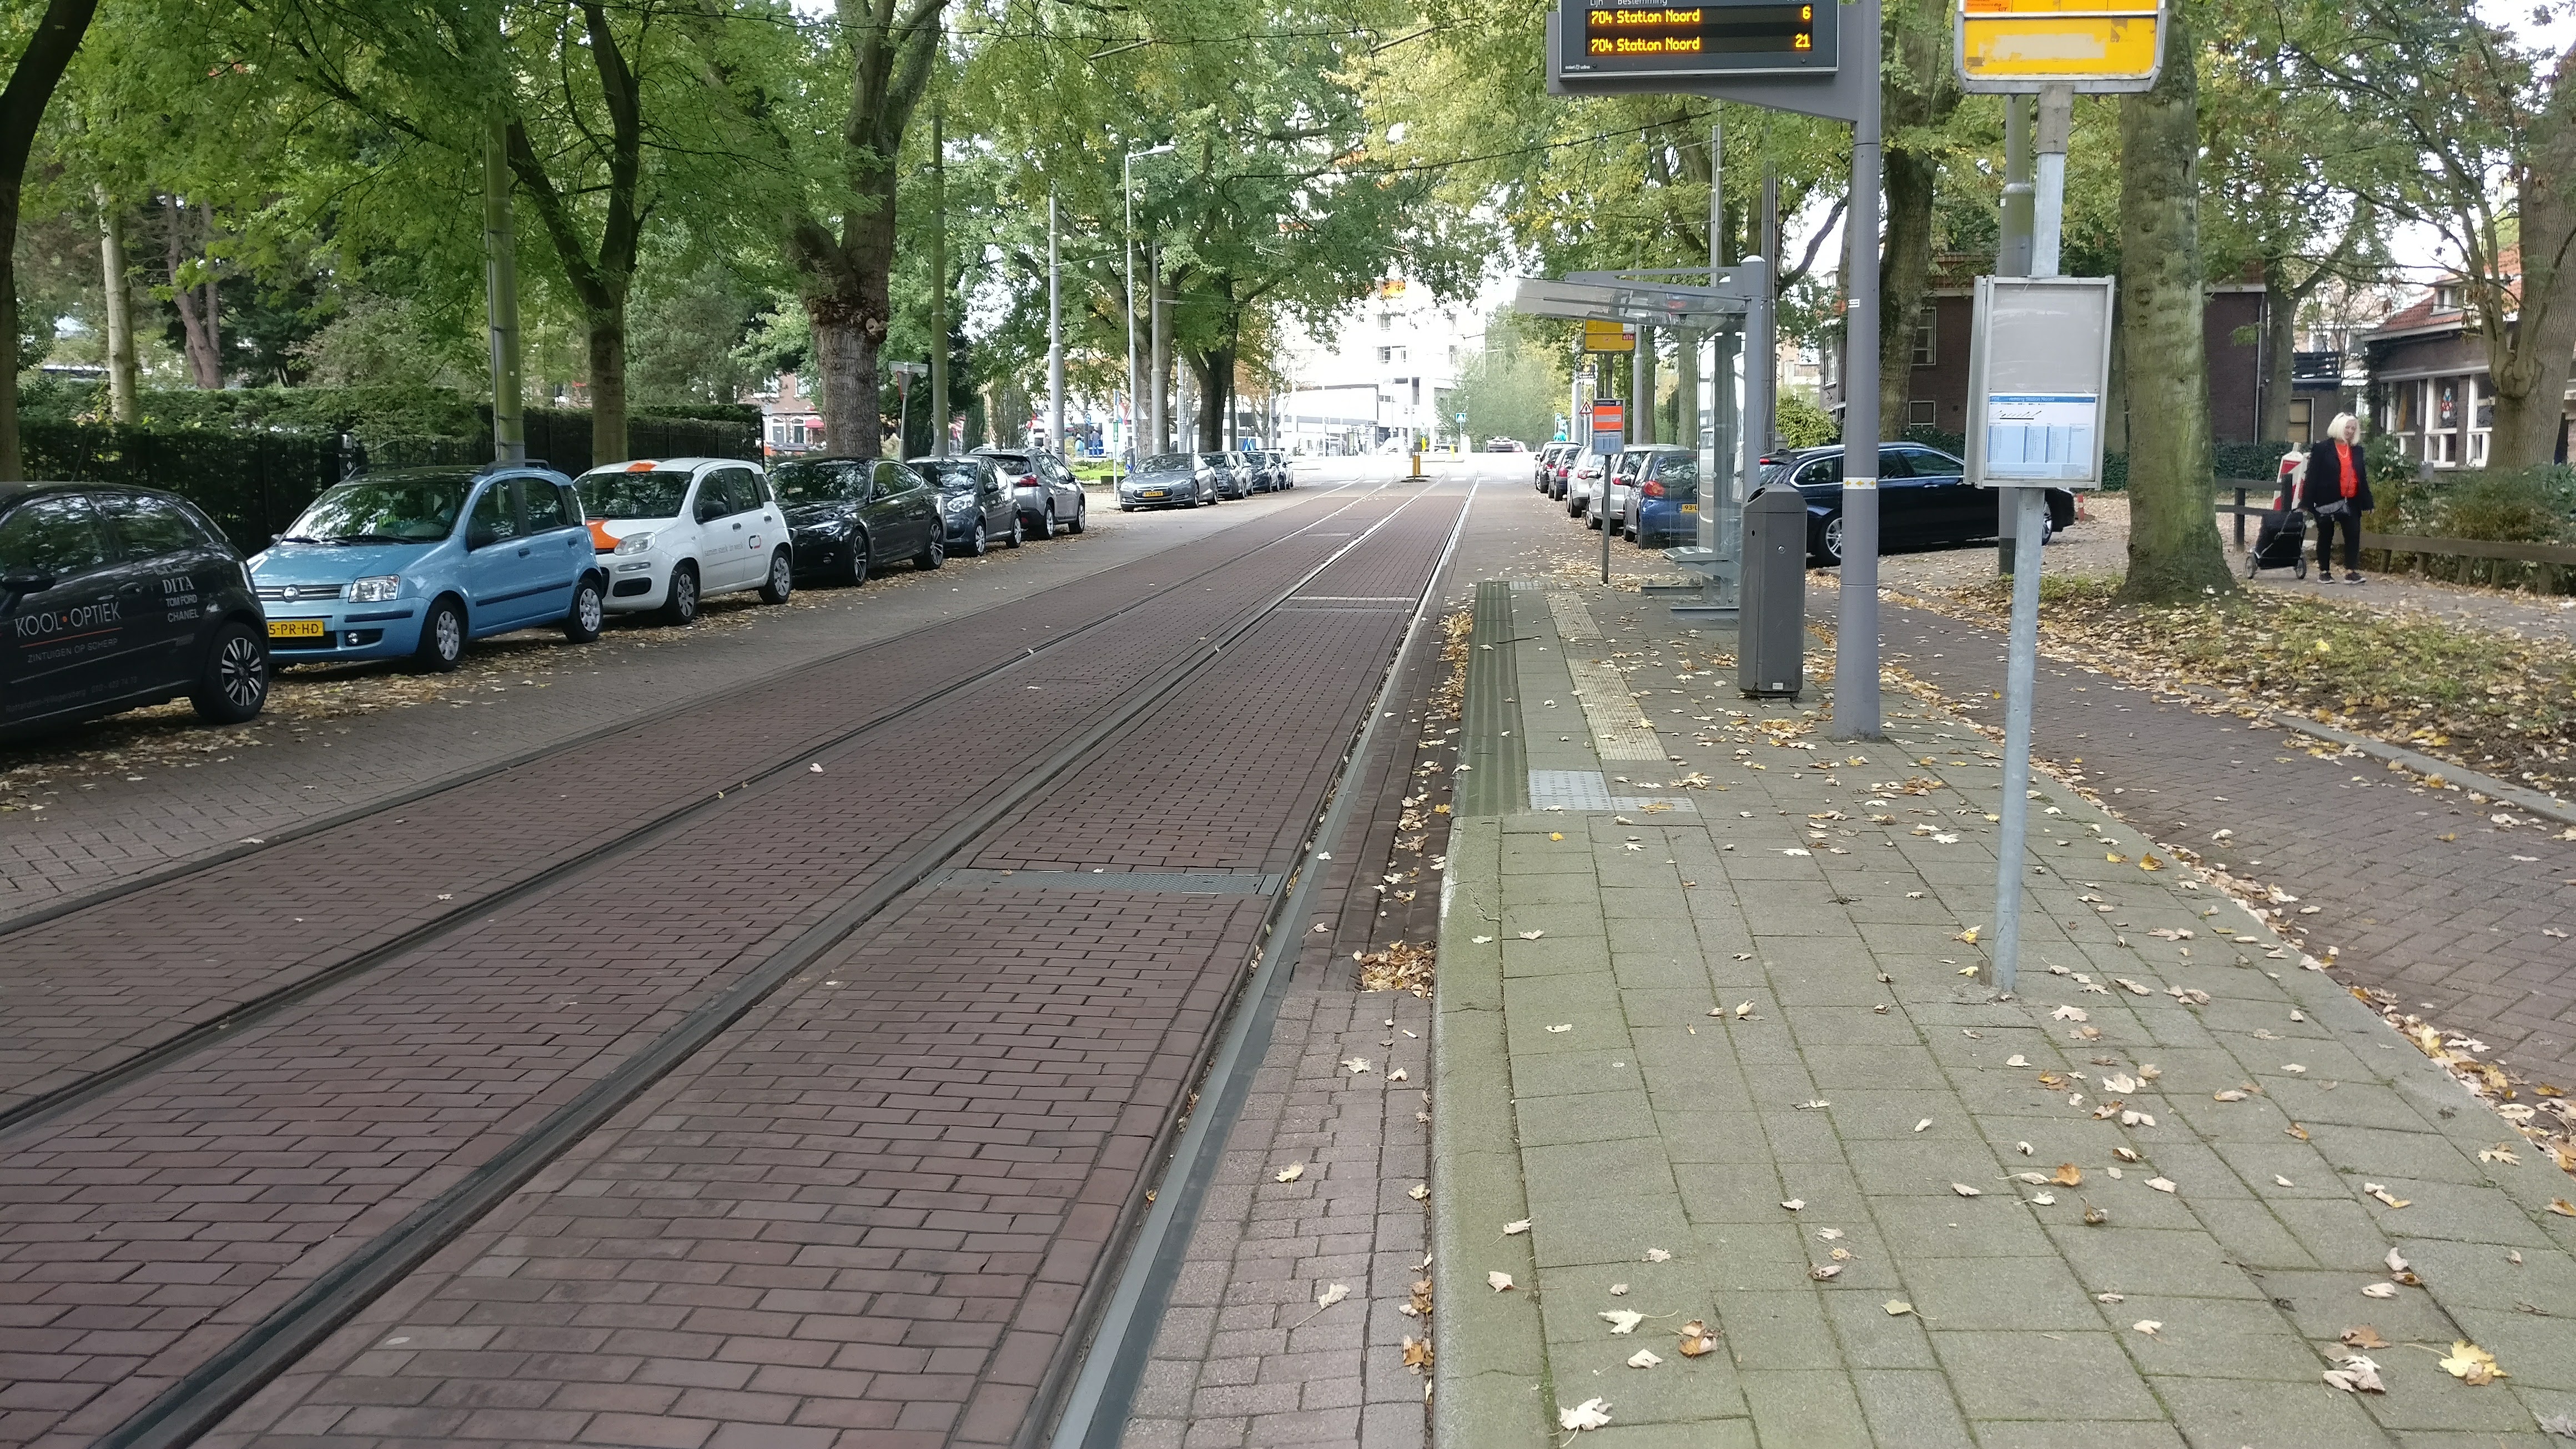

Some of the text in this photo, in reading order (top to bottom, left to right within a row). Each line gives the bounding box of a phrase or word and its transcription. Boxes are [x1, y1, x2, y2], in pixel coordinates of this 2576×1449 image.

[1591, 6, 1811, 24] 704 Station Noord 6
[1591, 33, 1810, 52] 704 Station Noord 21
[162, 576, 195, 594] DITA
[166, 594, 197, 607] TOM FORD
[14, 601, 122, 637] KOOL OPTIEK
[168, 608, 200, 622] CHANEL
[269, 623, 319, 635] 5-PR-HD
[28, 638, 118, 663] ZINTUIGEN OP SCHERP
